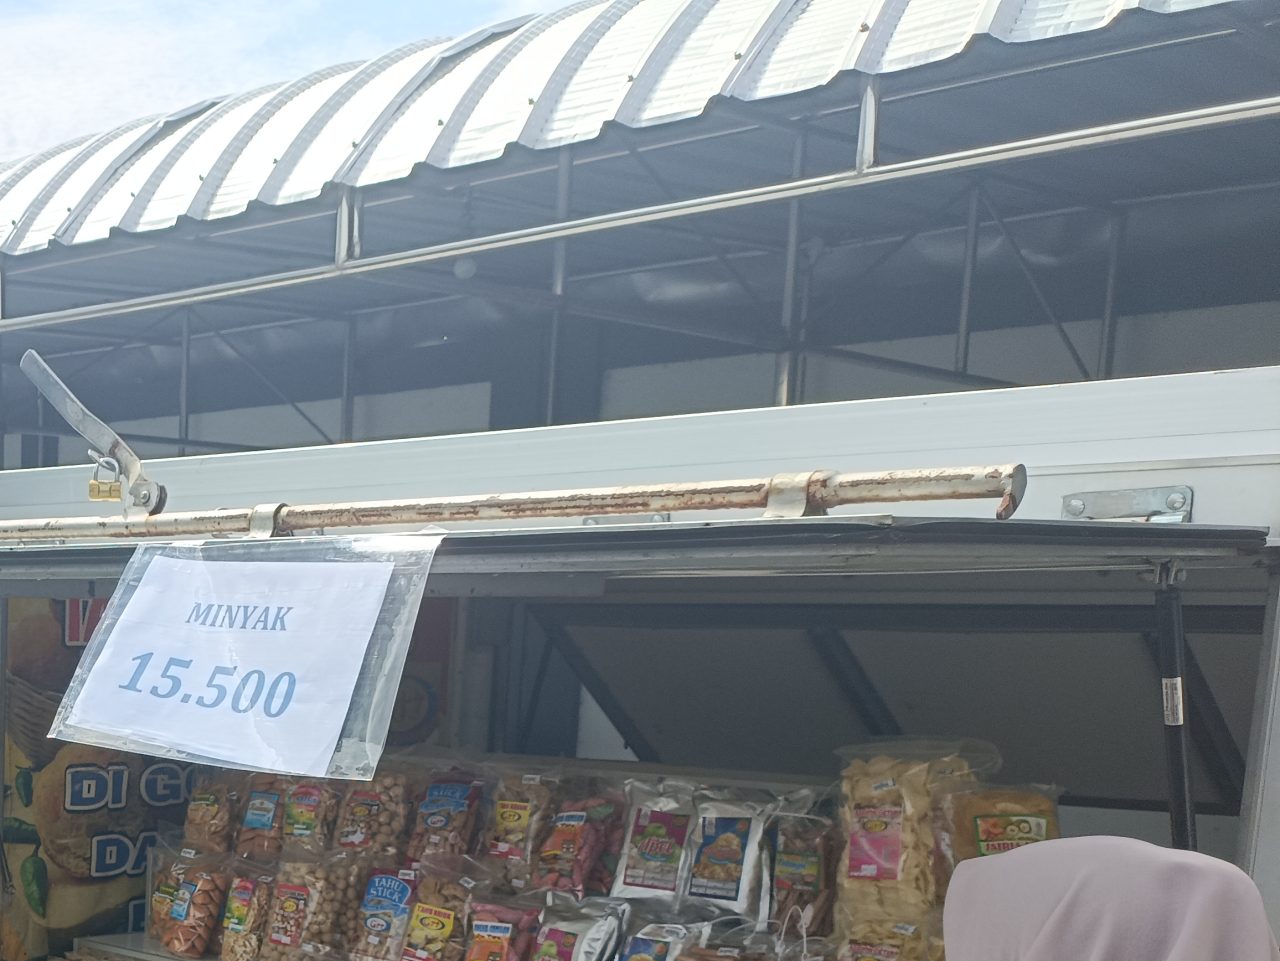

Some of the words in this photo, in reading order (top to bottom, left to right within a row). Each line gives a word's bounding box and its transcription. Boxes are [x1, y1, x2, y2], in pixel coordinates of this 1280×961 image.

[185, 602, 294, 631] MINYAK
[118, 652, 297, 718] 15.500
[370, 887, 401, 903] STICK
[375, 877, 403, 891] TAHU
